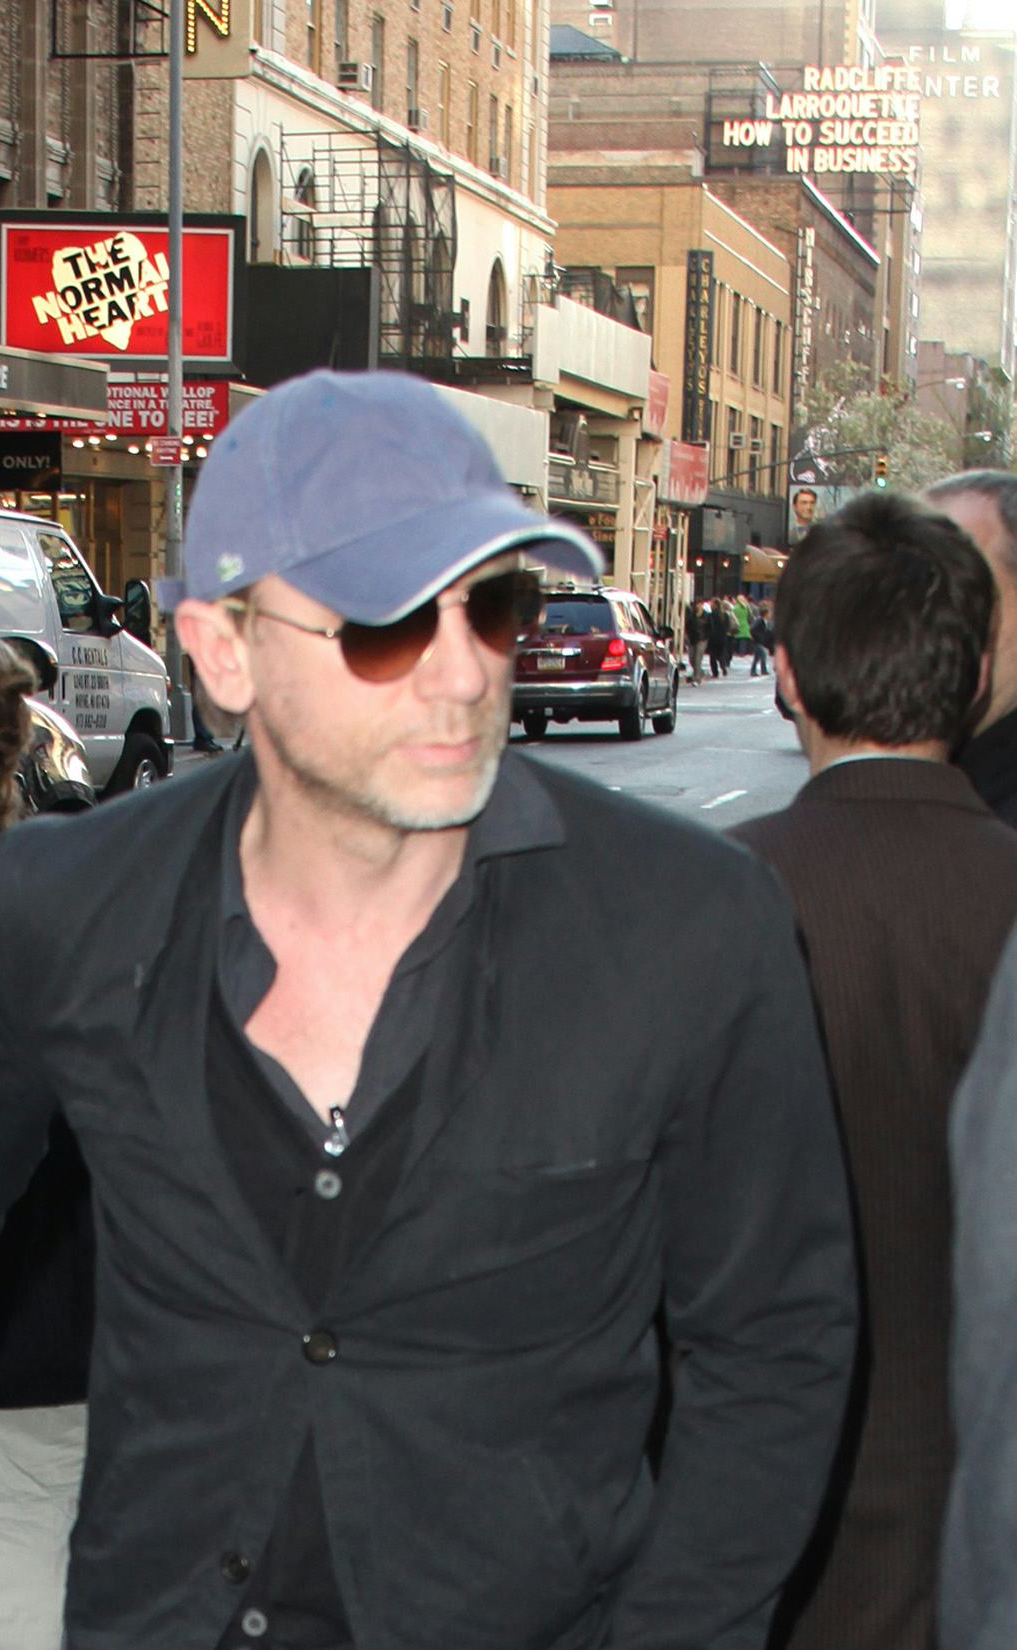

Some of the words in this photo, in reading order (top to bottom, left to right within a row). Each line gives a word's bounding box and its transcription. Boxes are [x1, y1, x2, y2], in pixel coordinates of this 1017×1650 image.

[186, 0, 230, 53] N
[908, 45, 981, 63] FILM
[804, 66, 921, 92] RADCLIFFE
[920, 76, 1001, 98] NTER
[723, 121, 772, 147] HOW
[783, 121, 812, 146] TO
[819, 121, 919, 146] SUCCEED
[787, 147, 809, 173] IN
[814, 147, 917, 173] BUSINESS
[62, 236, 131, 280] THE
[56, 281, 169, 345] HEART
[160, 386, 215, 398] WLLOP
[133, 399, 145, 410] IN
[147, 399, 157, 410] A
[138, 410, 165, 428] TO
[3, 455, 51, 469] ONLY!
